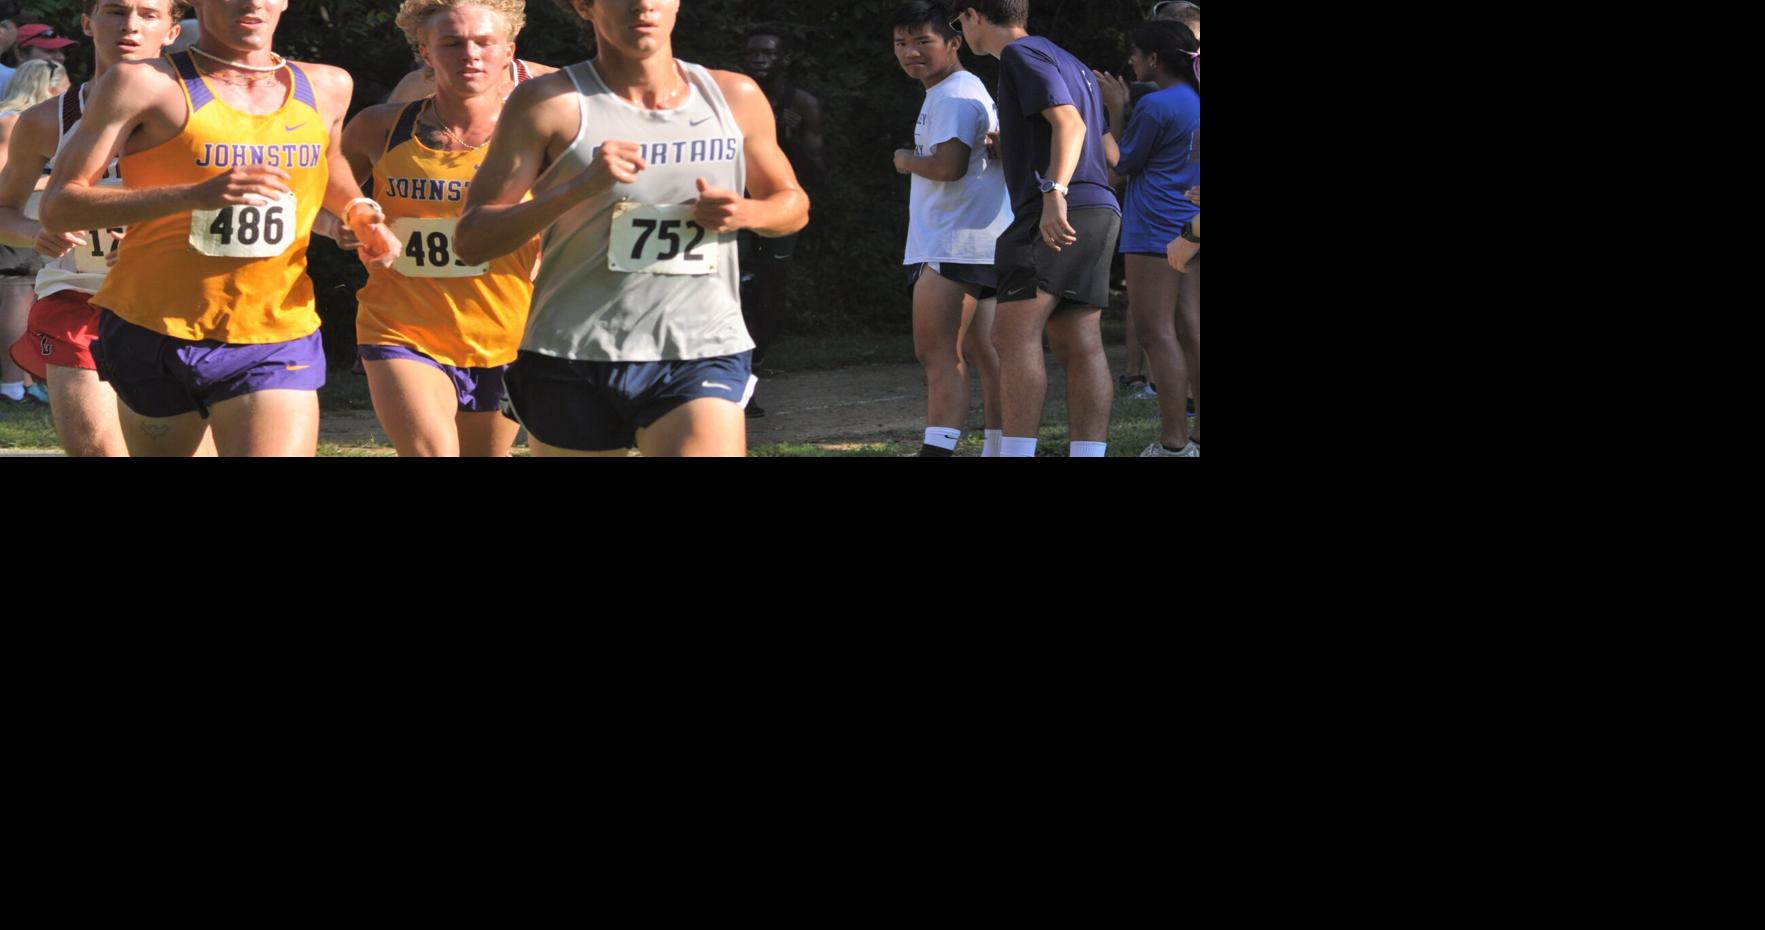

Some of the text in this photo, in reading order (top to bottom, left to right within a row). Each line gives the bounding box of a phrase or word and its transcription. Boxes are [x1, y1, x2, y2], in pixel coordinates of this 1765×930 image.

[195, 143, 321, 168] JOHNSTON
[210, 206, 284, 245] 486
[630, 218, 705, 261] 752
[405, 231, 466, 268] 48
